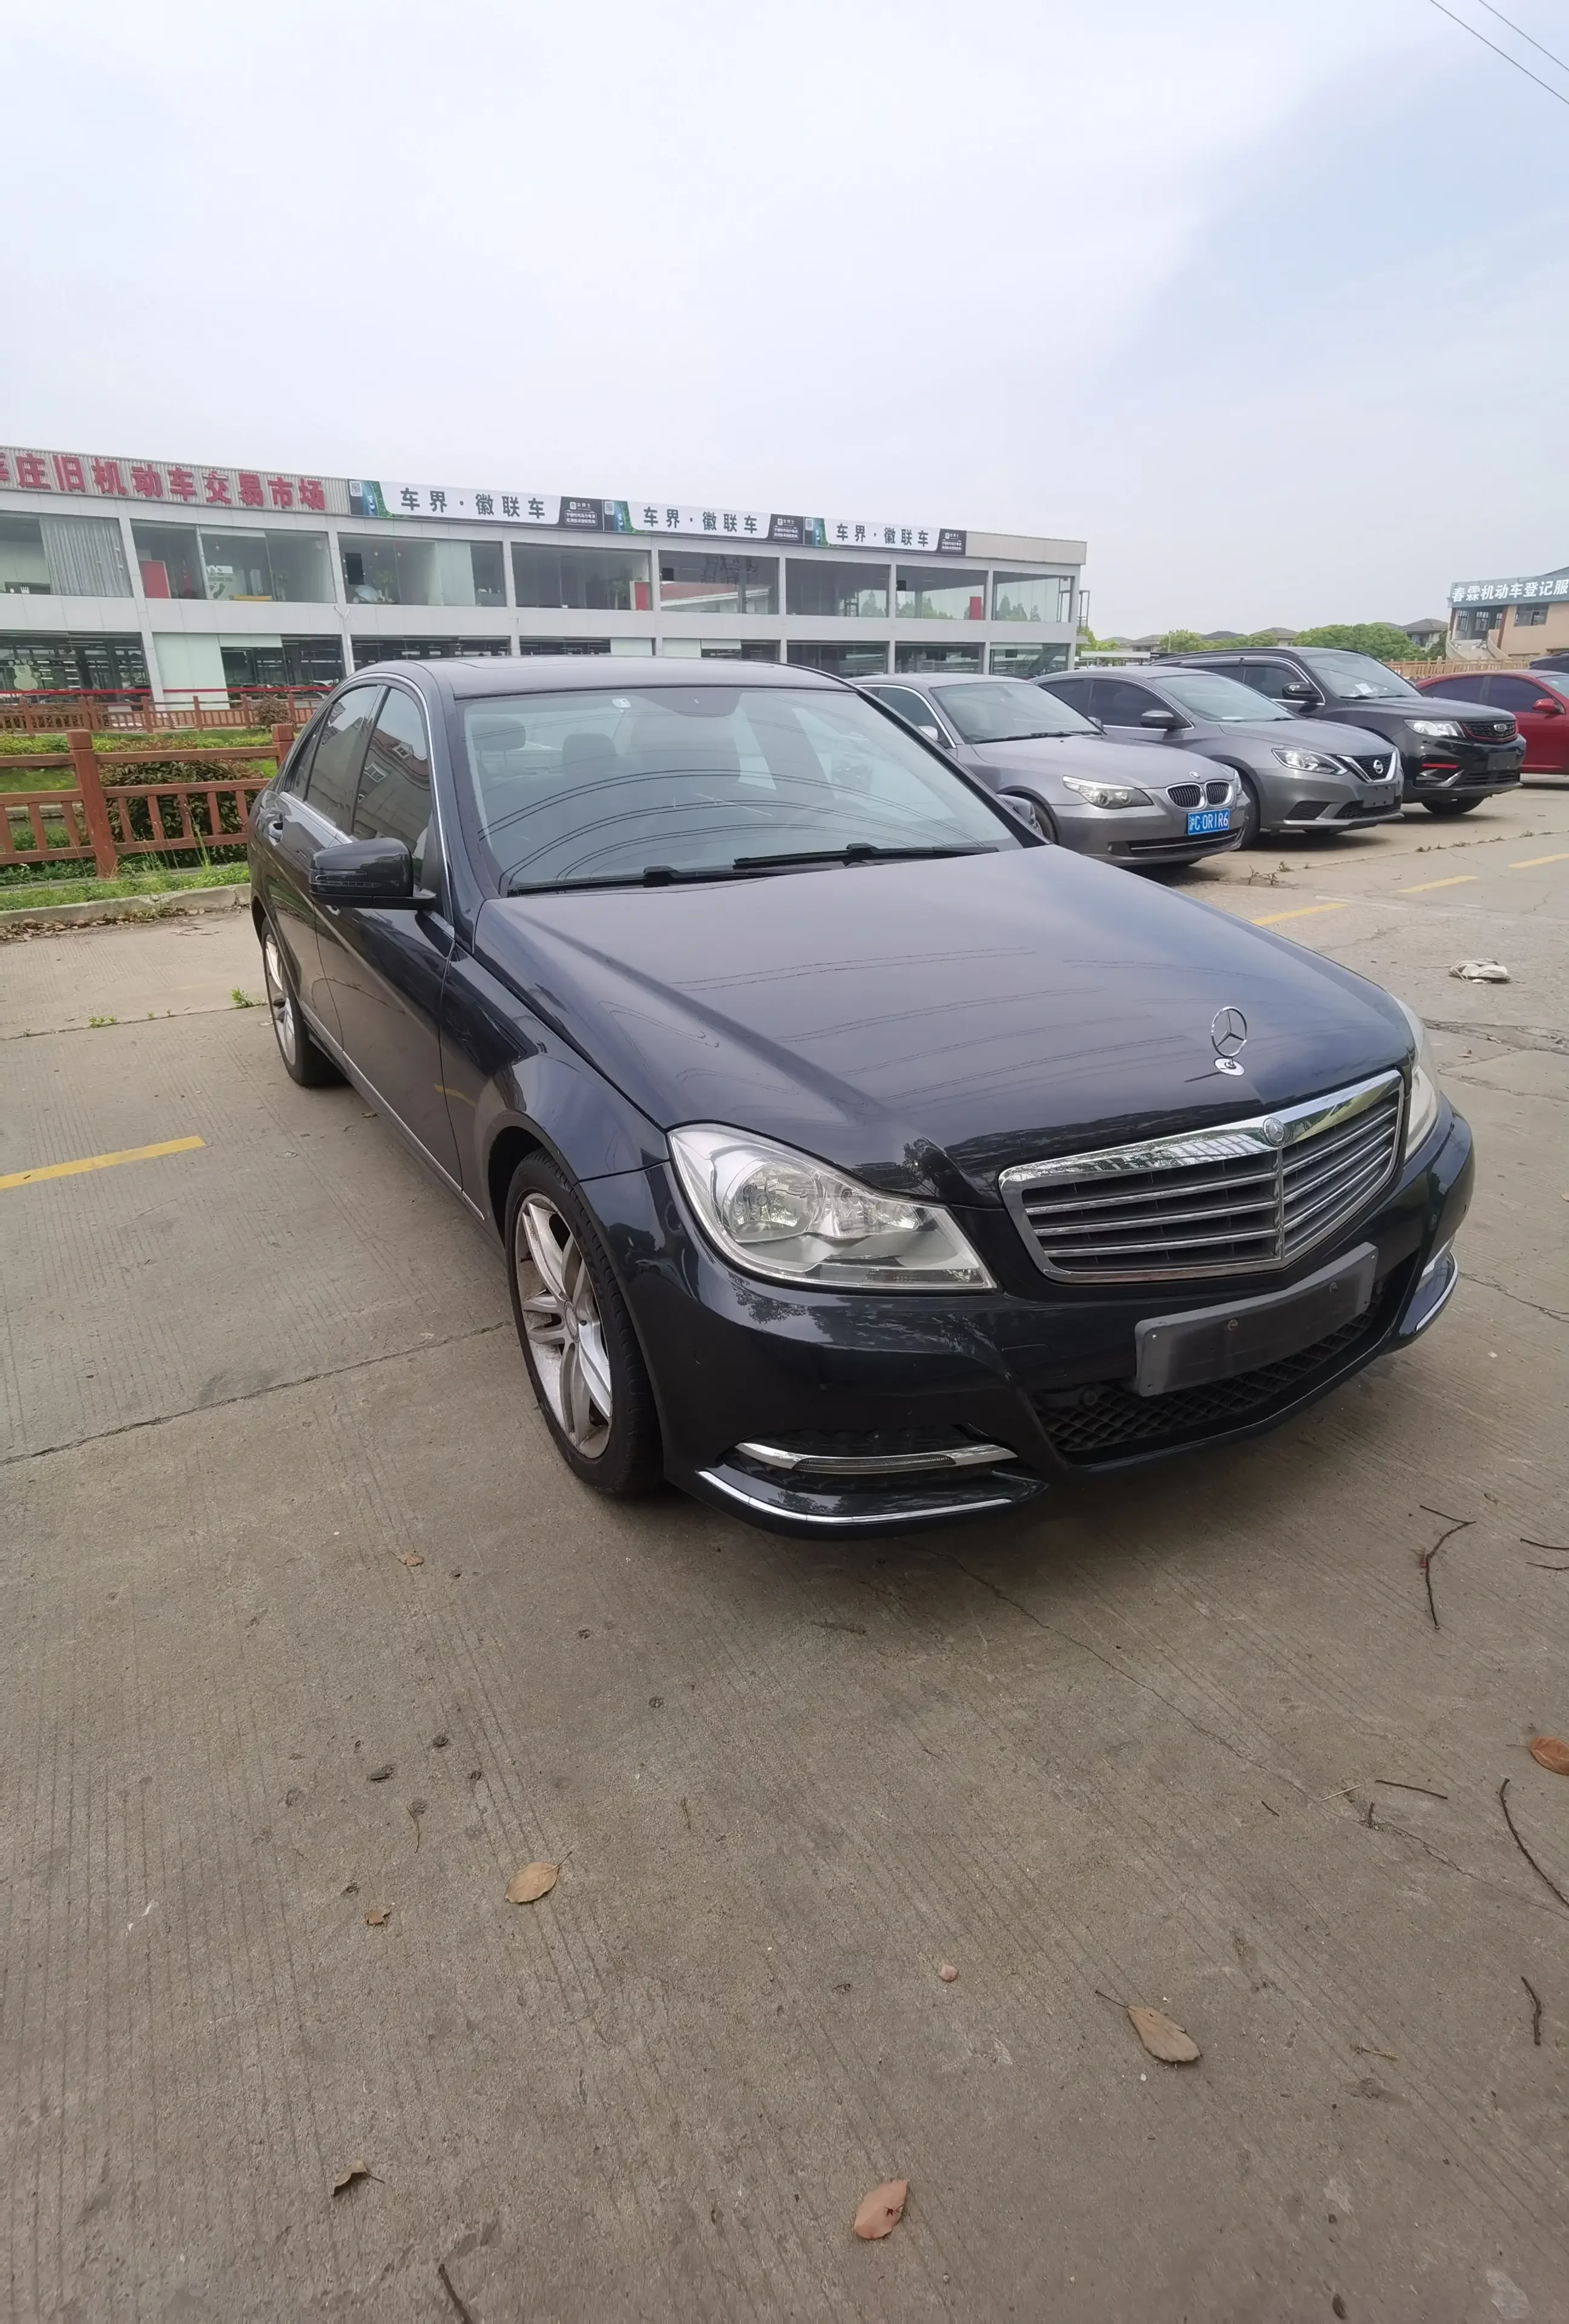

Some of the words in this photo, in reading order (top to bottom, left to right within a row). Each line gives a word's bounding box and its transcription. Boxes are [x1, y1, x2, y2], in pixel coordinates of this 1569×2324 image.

[400, 487, 545, 519] 车界·徽联车
